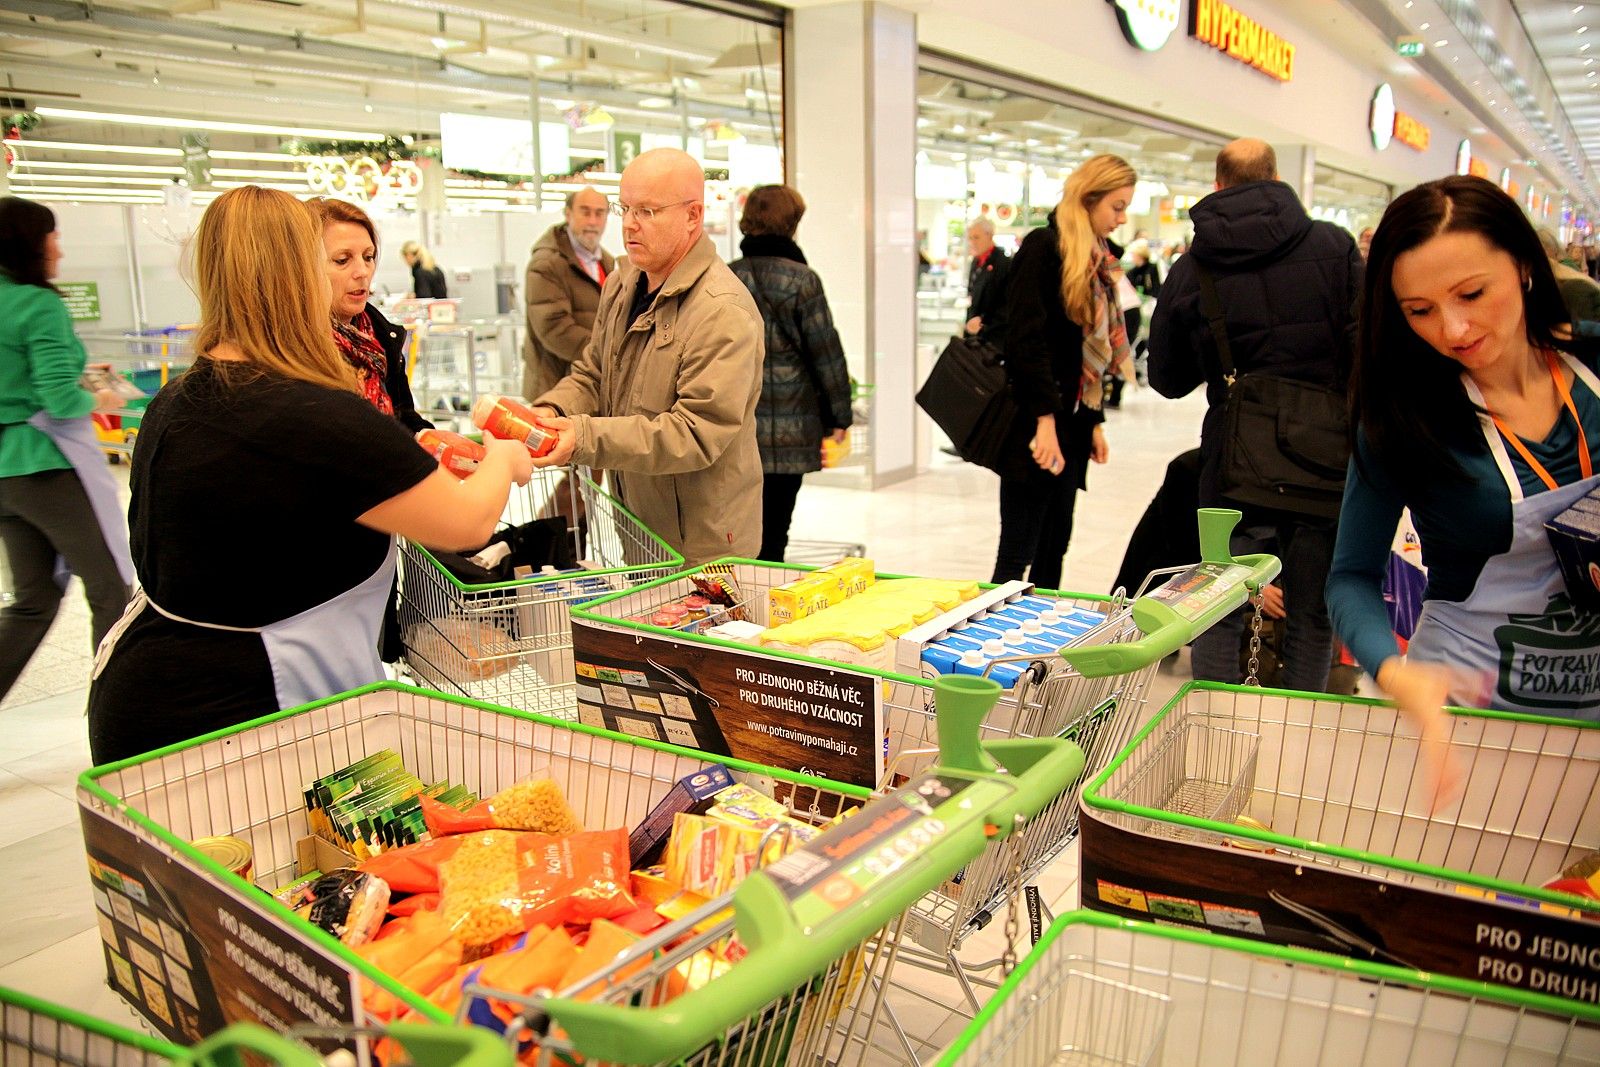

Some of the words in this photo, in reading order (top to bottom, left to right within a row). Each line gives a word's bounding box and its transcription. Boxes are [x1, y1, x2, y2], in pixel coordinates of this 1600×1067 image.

[1197, 0, 1296, 82] HYPERMARKET
[621, 140, 635, 168] 3
[735, 668, 756, 683] PRO
[757, 672, 805, 693] JEDNOHO
[807, 680, 840, 701] BĚŽNÁ
[841, 687, 865, 707] VĚC,
[739, 689, 759, 704] PRO
[761, 694, 809, 715] DRUHÉHO
[810, 703, 863, 728] VZÁCNOST
[747, 720, 858, 756] www.potravinypomahaji.cz
[1476, 923, 1521, 951] PRO
[1478, 956, 1523, 984] PRO
[1530, 967, 1600, 1003] DRUH
